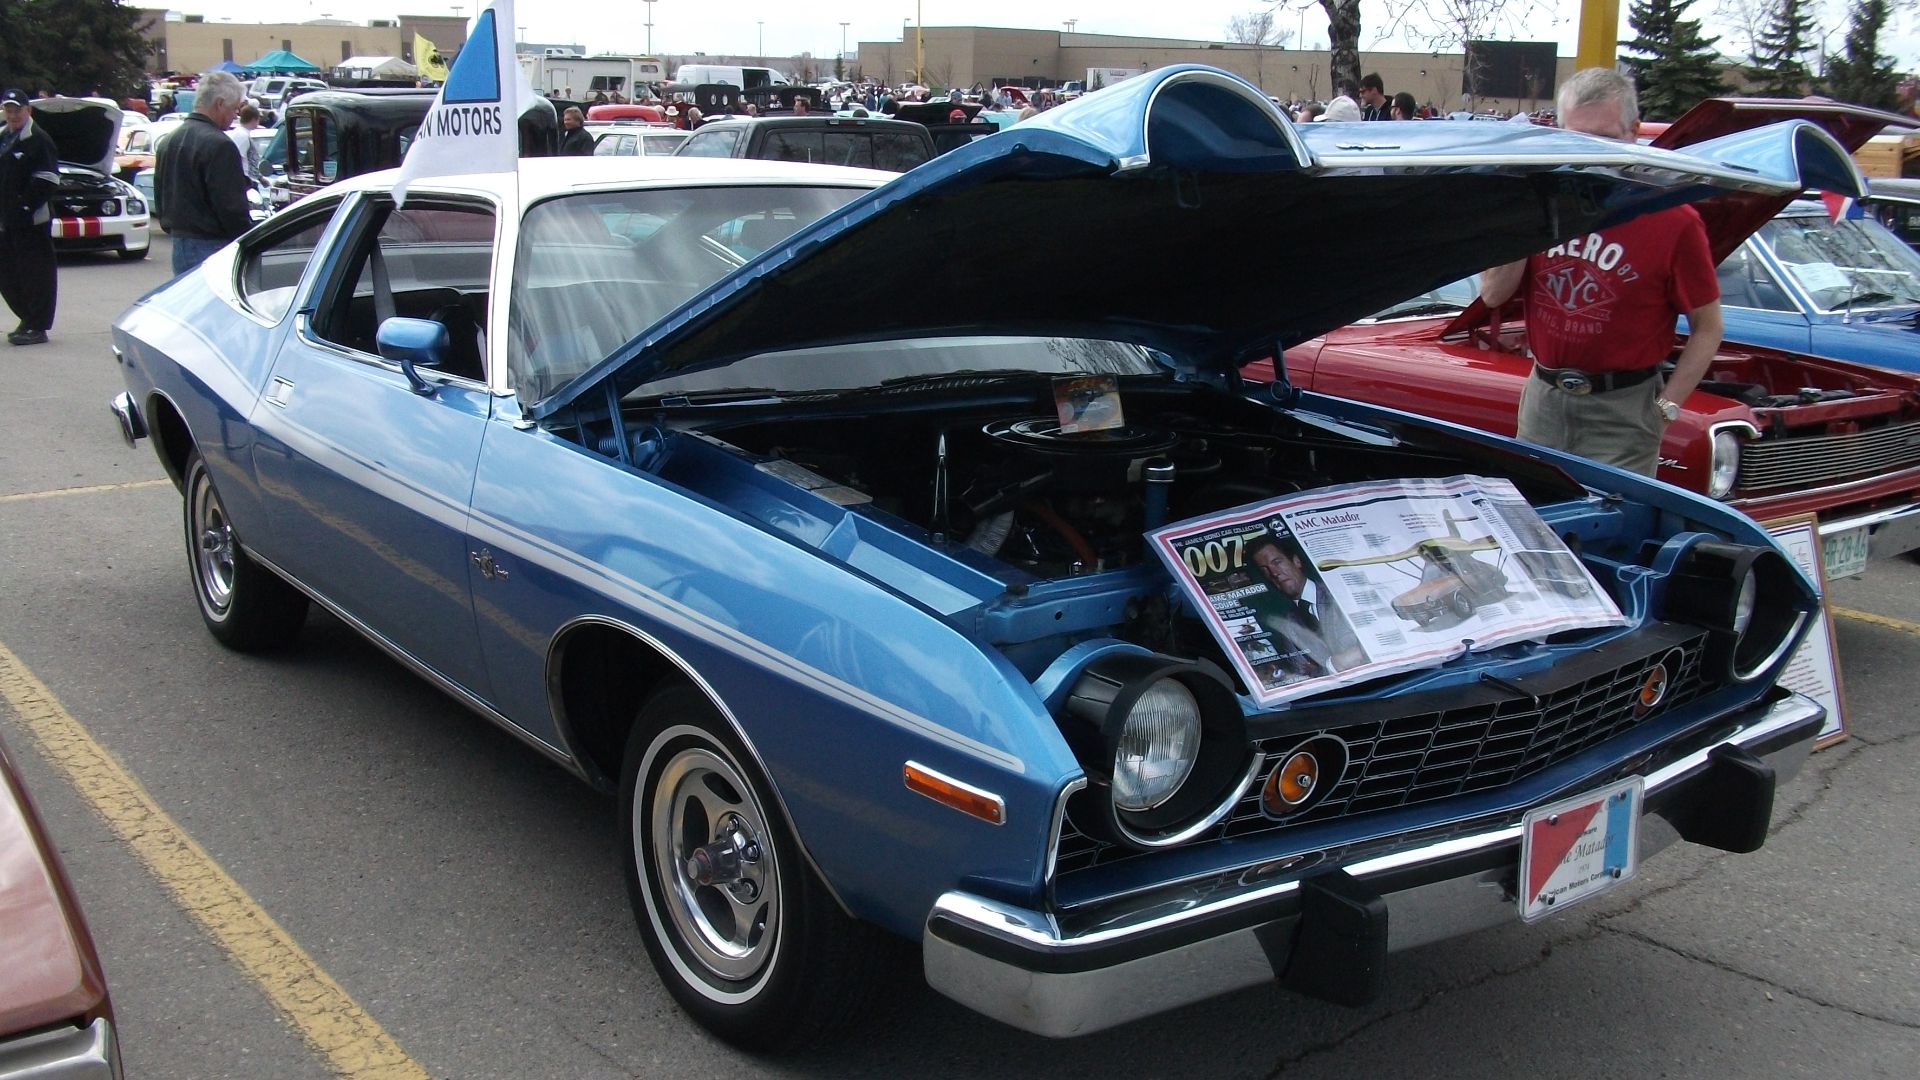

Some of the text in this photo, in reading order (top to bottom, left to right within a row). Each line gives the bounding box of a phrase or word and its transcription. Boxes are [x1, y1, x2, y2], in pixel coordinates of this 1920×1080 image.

[437, 106, 502, 137] MOTORS
[1547, 232, 1640, 284] AERO 87
[1546, 267, 1599, 310] NYC
[1564, 319, 1603, 335] BRAND
[1295, 516, 1321, 532] AMC
[1321, 511, 1361, 527] Matador
[1185, 536, 1204, 546] JAMES
[1204, 532, 1221, 541] BOND
[1233, 523, 1265, 535] COLLECTION
[1183, 534, 1249, 578] 007
[1209, 583, 1268, 604] AMC MATADOR
[1213, 599, 1241, 611] COUPE
[1568, 877, 1590, 891] Motors
